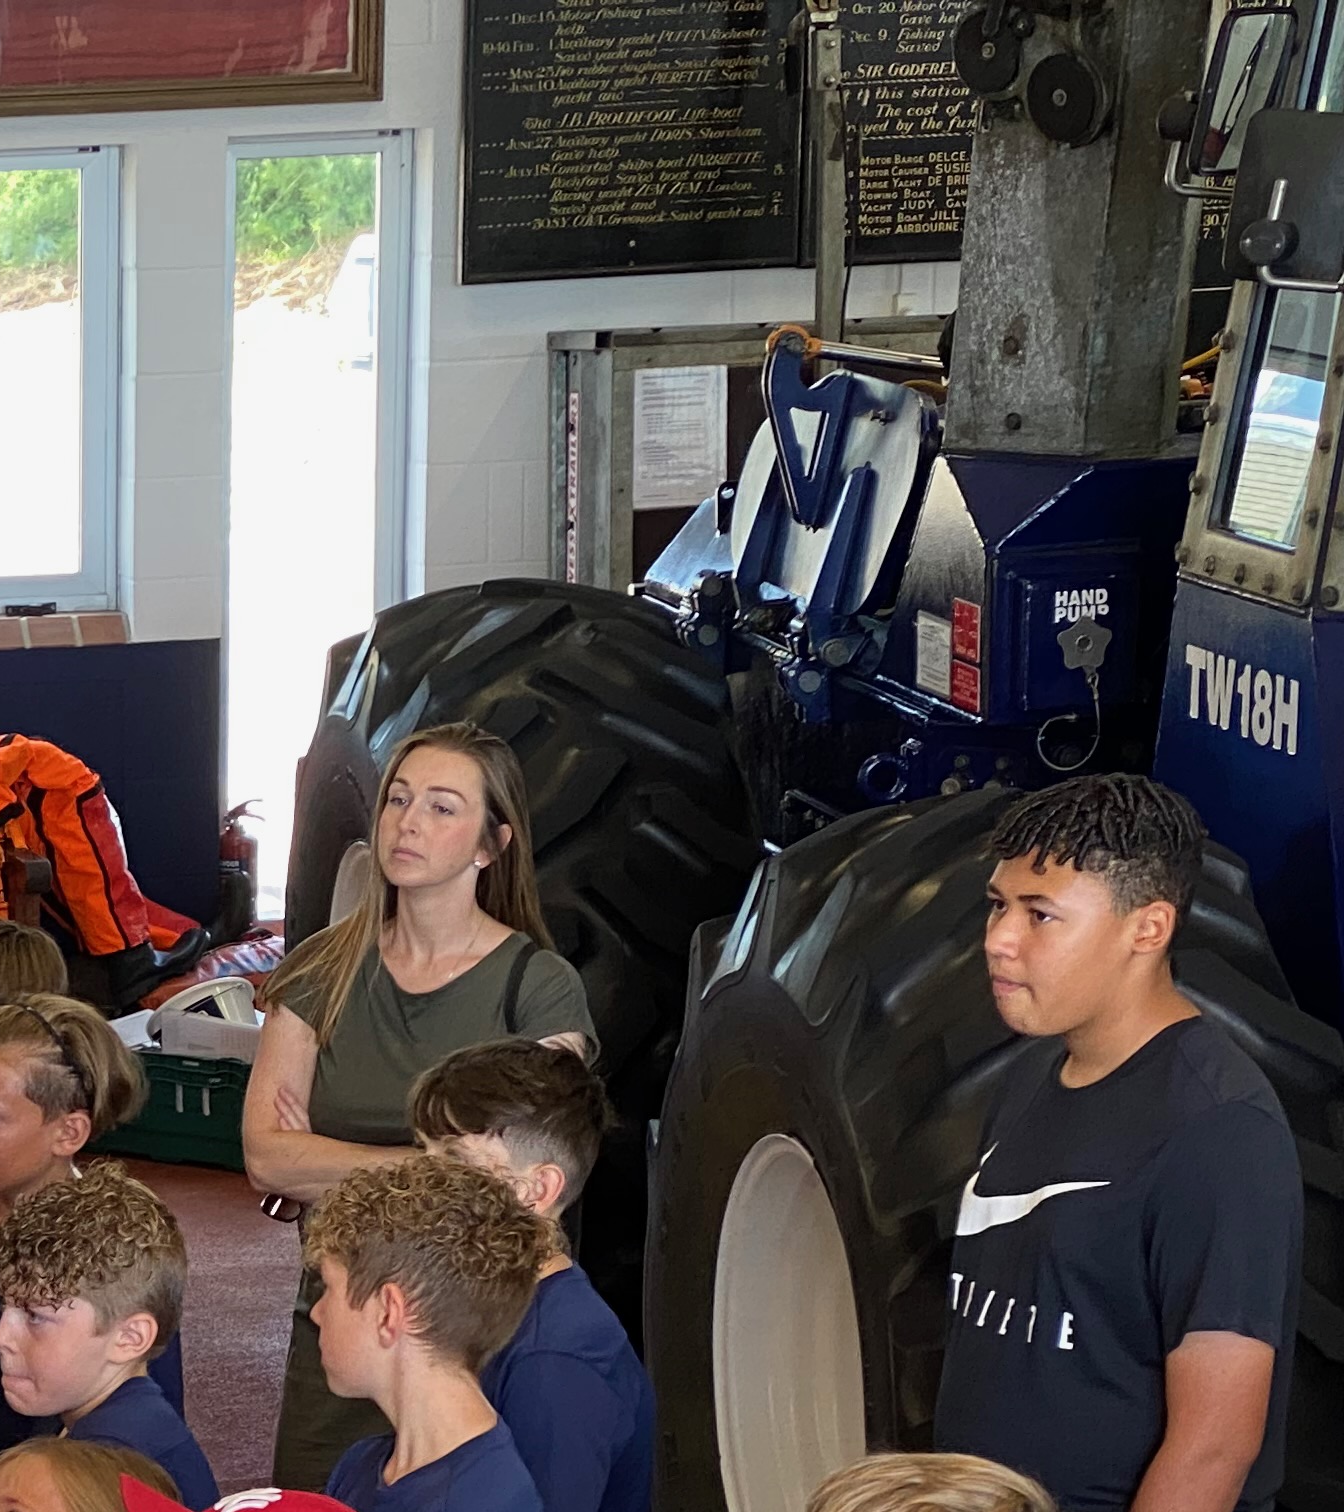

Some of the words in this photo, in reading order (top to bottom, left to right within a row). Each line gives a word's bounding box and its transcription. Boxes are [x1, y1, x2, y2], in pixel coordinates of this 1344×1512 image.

[899, 1, 937, 12] Motor
[899, 14, 933, 25] Gave
[938, 11, 962, 24] hel
[897, 27, 945, 42] Fishing
[895, 41, 941, 54] Saved
[855, 63, 885, 79] SIR
[875, 85, 904, 100] this
[911, 84, 971, 97] station
[876, 104, 901, 118] The
[906, 102, 939, 117] cost
[945, 101, 965, 117] of
[896, 119, 915, 135] by
[920, 117, 944, 130] the
[947, 116, 978, 133] fun
[859, 156, 892, 166] MOTOR
[894, 154, 925, 165] BARGE
[858, 168, 890, 178] MOTOR
[891, 166, 930, 177] CRUISER
[859, 179, 889, 190] BARGE
[892, 177, 923, 188] YACHT
[927, 175, 943, 187] DE
[858, 190, 899, 201] ROWING
[859, 202, 893, 213] YACHT
[858, 214, 893, 225] MOTOR
[897, 212, 925, 223] BOAT
[859, 226, 892, 236] YACHT
[1054, 588, 1109, 607] HAND
[1185, 644, 1301, 756] TW18H
